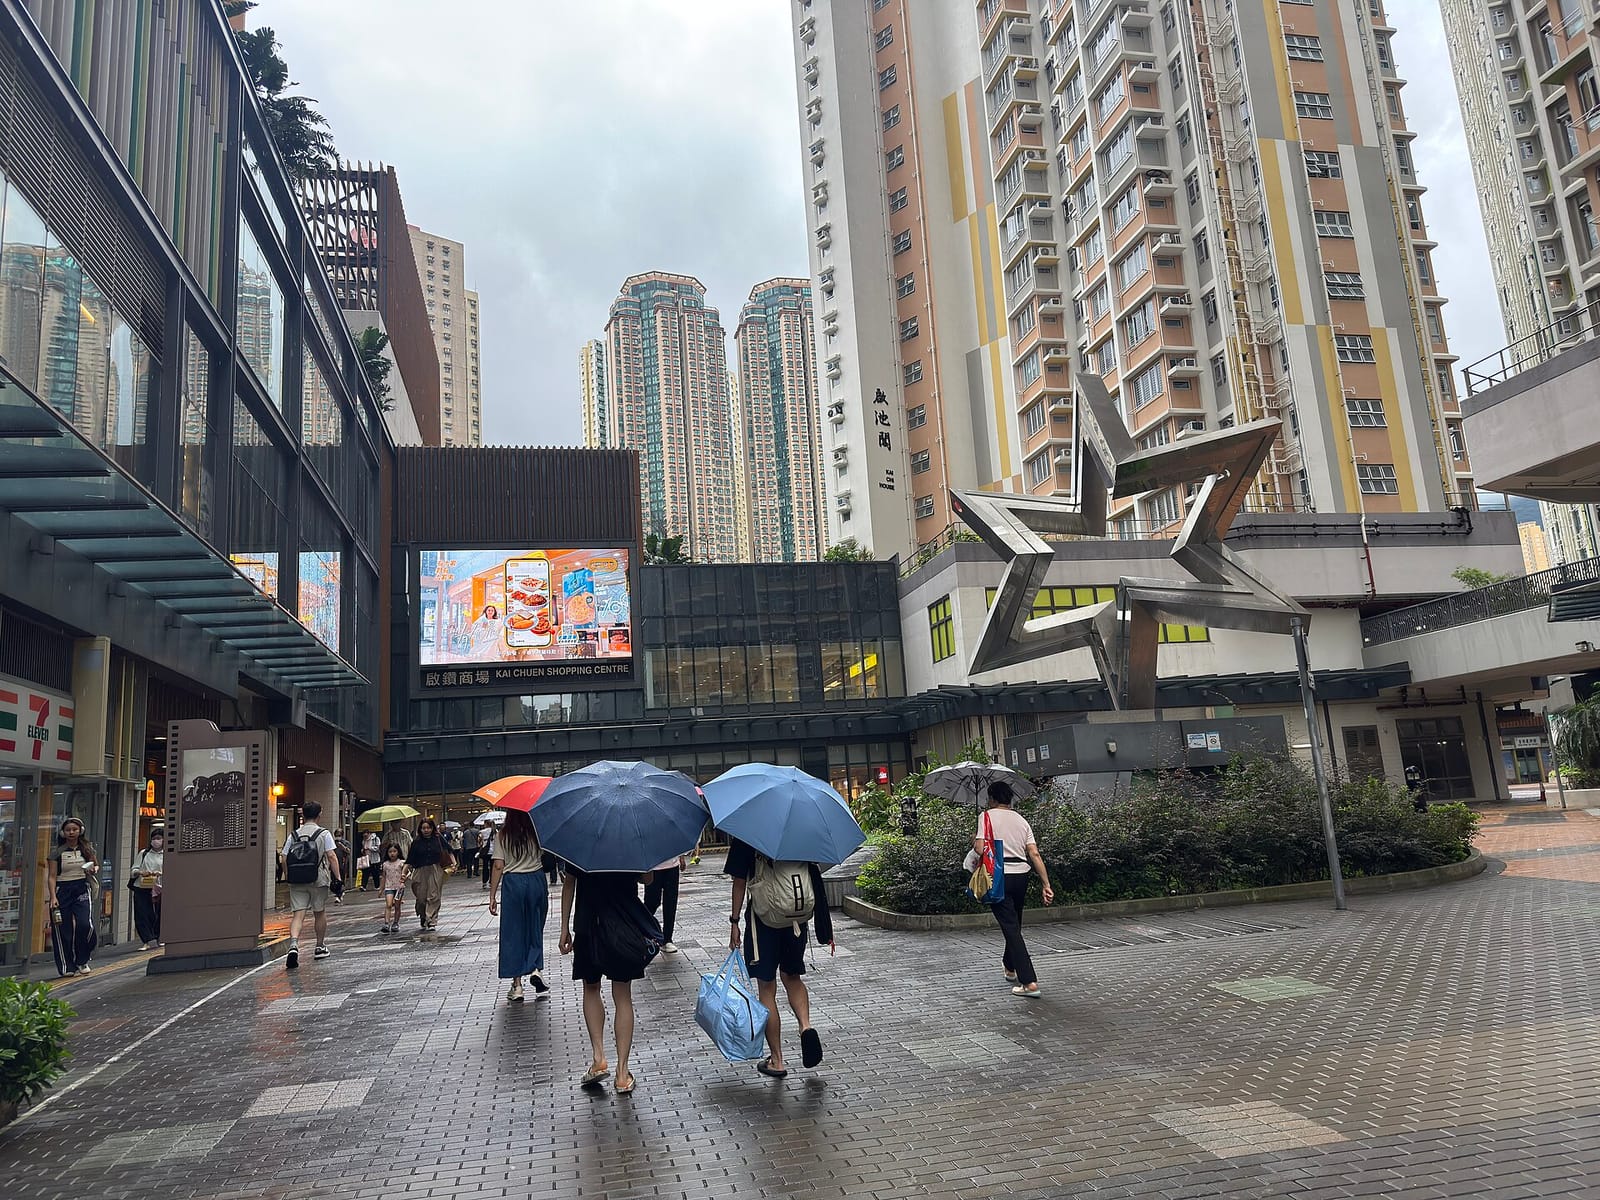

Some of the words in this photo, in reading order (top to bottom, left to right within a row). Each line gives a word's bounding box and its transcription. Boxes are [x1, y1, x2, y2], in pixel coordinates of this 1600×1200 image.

[426, 670, 490, 687] 啟鑽商場
[495, 669, 511, 678] KAI
[513, 668, 545, 677] CHUEN
[546, 666, 592, 676] SHOPPING
[594, 664, 629, 674] CENTRE
[29, 694, 50, 761] 7
